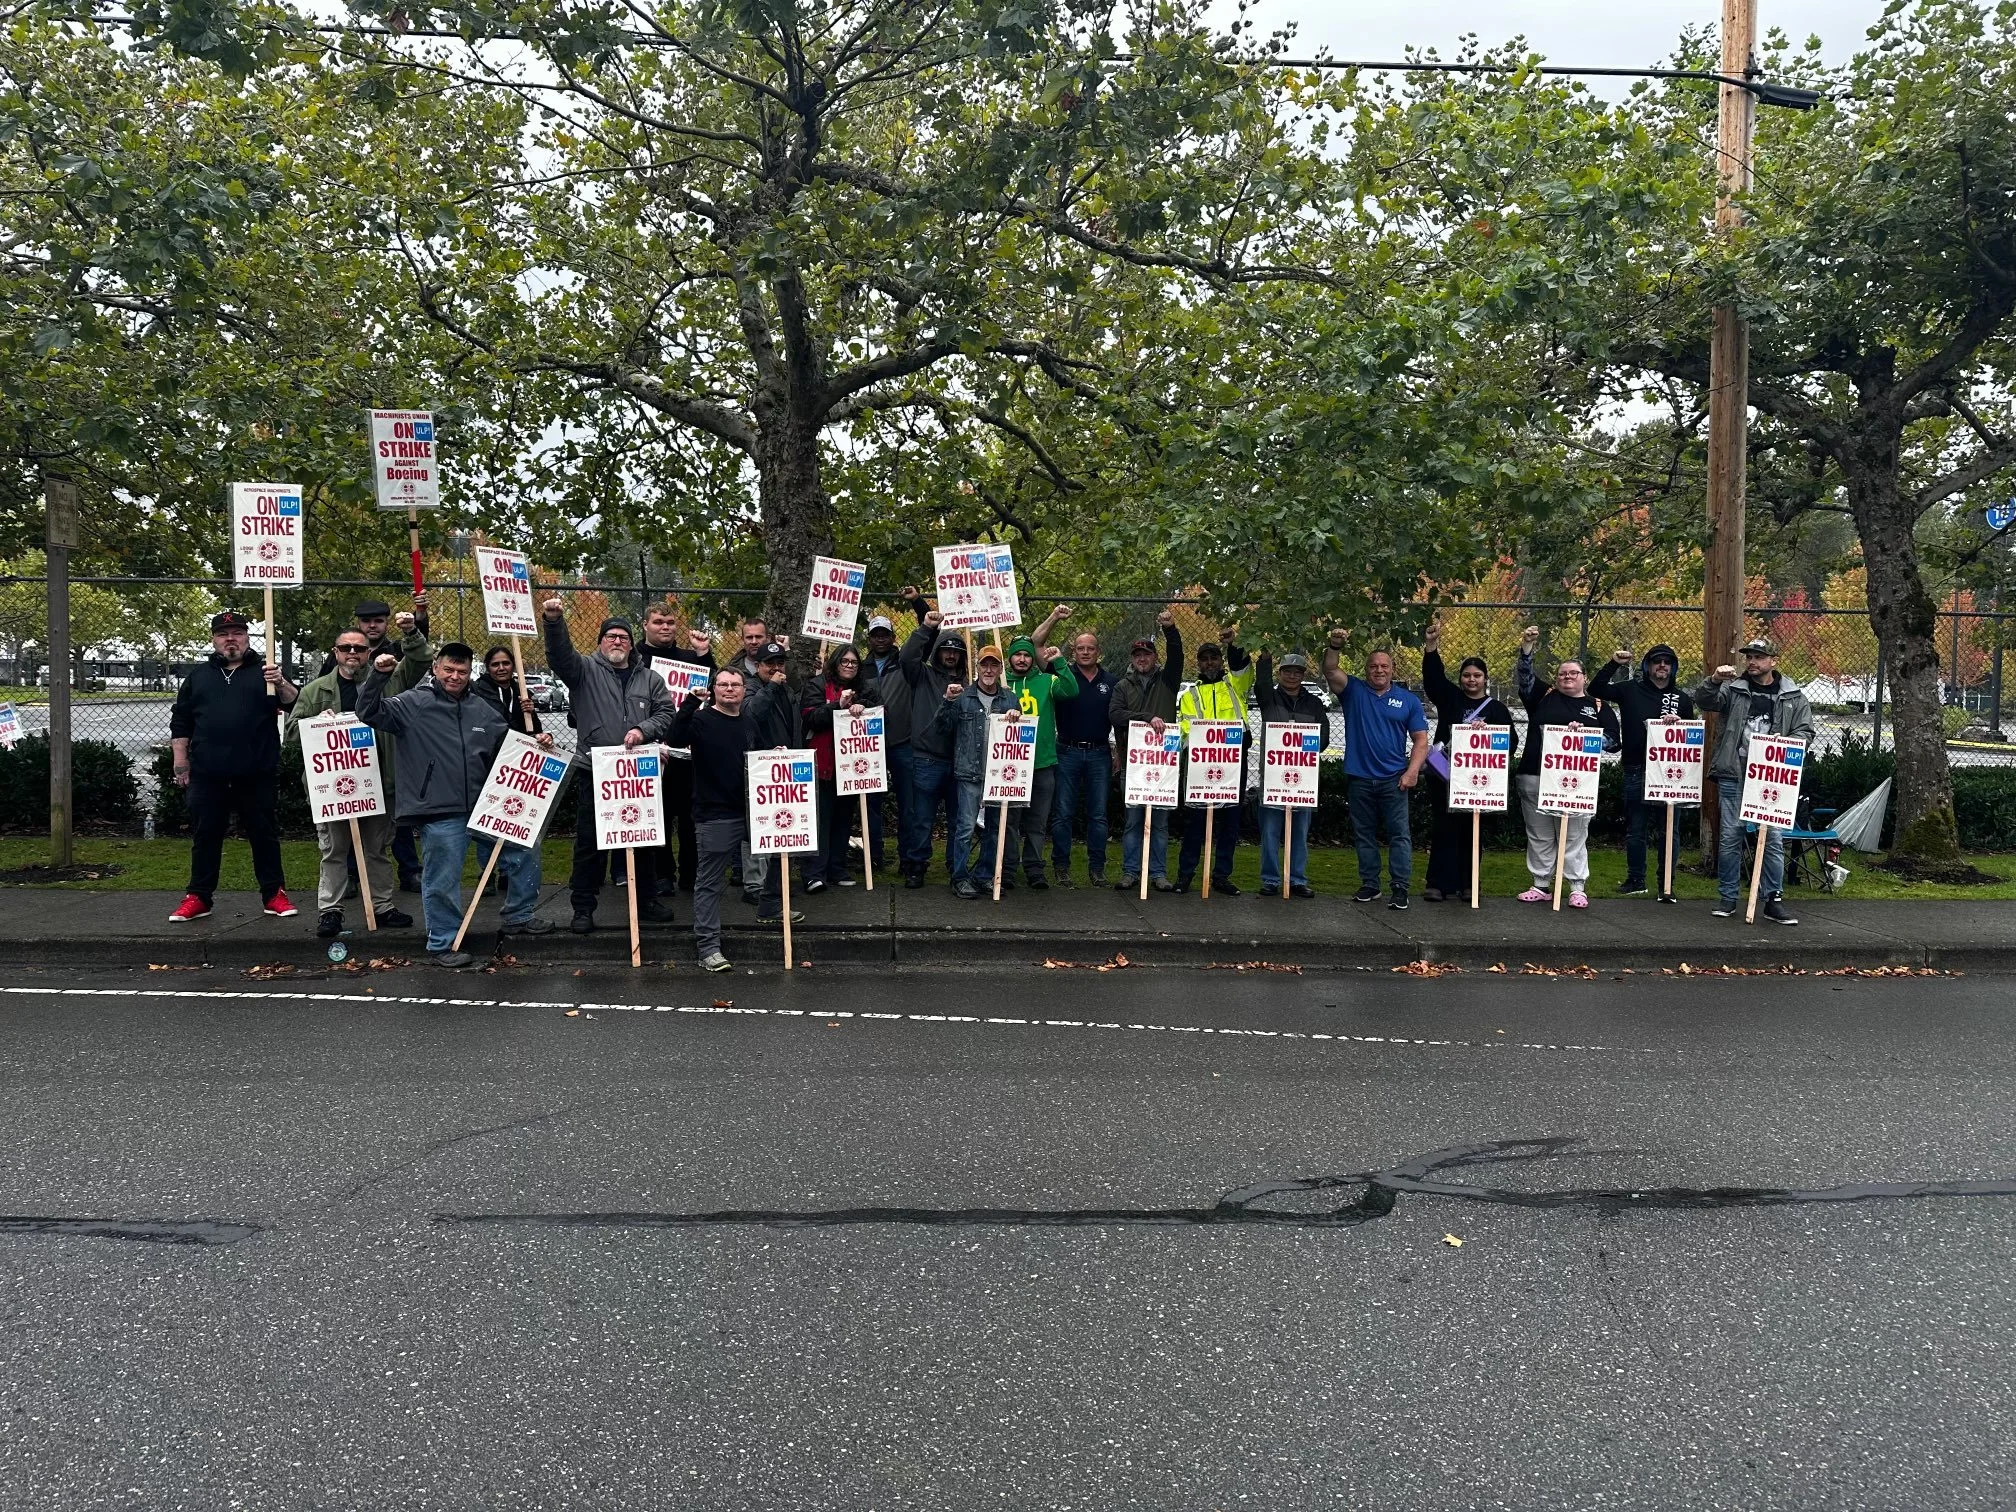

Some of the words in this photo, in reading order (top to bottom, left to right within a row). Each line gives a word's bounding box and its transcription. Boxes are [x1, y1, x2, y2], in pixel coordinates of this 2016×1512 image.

[394, 422, 414, 438] ON
[379, 441, 431, 457] STRIKE
[387, 468, 428, 481] Boeing
[257, 496, 278, 515] ON
[242, 516, 294, 535] STRIKE
[494, 558, 512, 574] ON
[951, 554, 970, 570] ON
[987, 557, 995, 573] N
[244, 566, 256, 577] AT
[259, 566, 294, 578] BOEING
[830, 568, 848, 584] ON
[483, 575, 528, 594] STRIKE
[938, 571, 986, 590] STRIKE
[812, 583, 859, 605] STRIKE
[957, 616, 989, 624] BOEING
[992, 612, 1014, 624] OEING
[505, 623, 534, 631] BOEING
[820, 629, 851, 639] BOEING
[655, 659, 680, 668] AEROSPACE
[668, 670, 690, 688] ON
[691, 678, 705, 686] ULP!
[352, 732, 370, 740] ULP!
[851, 720, 866, 736] ON
[1005, 726, 1020, 742] ON
[1206, 728, 1226, 743] ON
[327, 729, 350, 750] ON
[1144, 731, 1163, 746] ON
[1283, 732, 1302, 747] ON
[1470, 734, 1490, 749] ON
[1562, 736, 1583, 751] ON
[1665, 729, 1686, 744] ON
[840, 736, 879, 754] STRIKE
[993, 743, 1030, 760] STRIKE
[312, 748, 370, 773] STRIKE
[1130, 749, 1177, 766] STRIKE
[1192, 748, 1239, 763] STRIKE
[1267, 750, 1316, 767] STRIKE
[1454, 752, 1506, 769] STRIKE
[1649, 747, 1701, 762] STRIKE
[1765, 745, 1786, 763] ON
[1787, 751, 1801, 760] ULP!
[521, 751, 545, 774] ON
[545, 763, 562, 774] ULP!
[616, 759, 637, 778] ON
[1544, 754, 1598, 772] STRIKE
[772, 764, 792, 783] ON
[1748, 763, 1799, 786] STRIKE
[496, 765, 551, 799] STRIKE
[602, 779, 654, 800] STRIKE
[844, 781, 852, 791] AT
[855, 778, 881, 790] BOEING
[757, 784, 808, 805] STRIKE
[989, 786, 999, 796] AT
[1000, 786, 1025, 797] BOEING
[1143, 795, 1175, 803] BOEING
[322, 804, 334, 817] AT
[338, 798, 376, 814] BOEING
[1558, 801, 1594, 809] BOEING
[477, 814, 493, 827] AT
[492, 818, 530, 840] BOEING
[1757, 813, 1791, 825] BOEING
[606, 832, 618, 844] AT
[621, 829, 657, 843] BOEING
[760, 836, 771, 848] AT
[774, 834, 809, 847] BOEING
